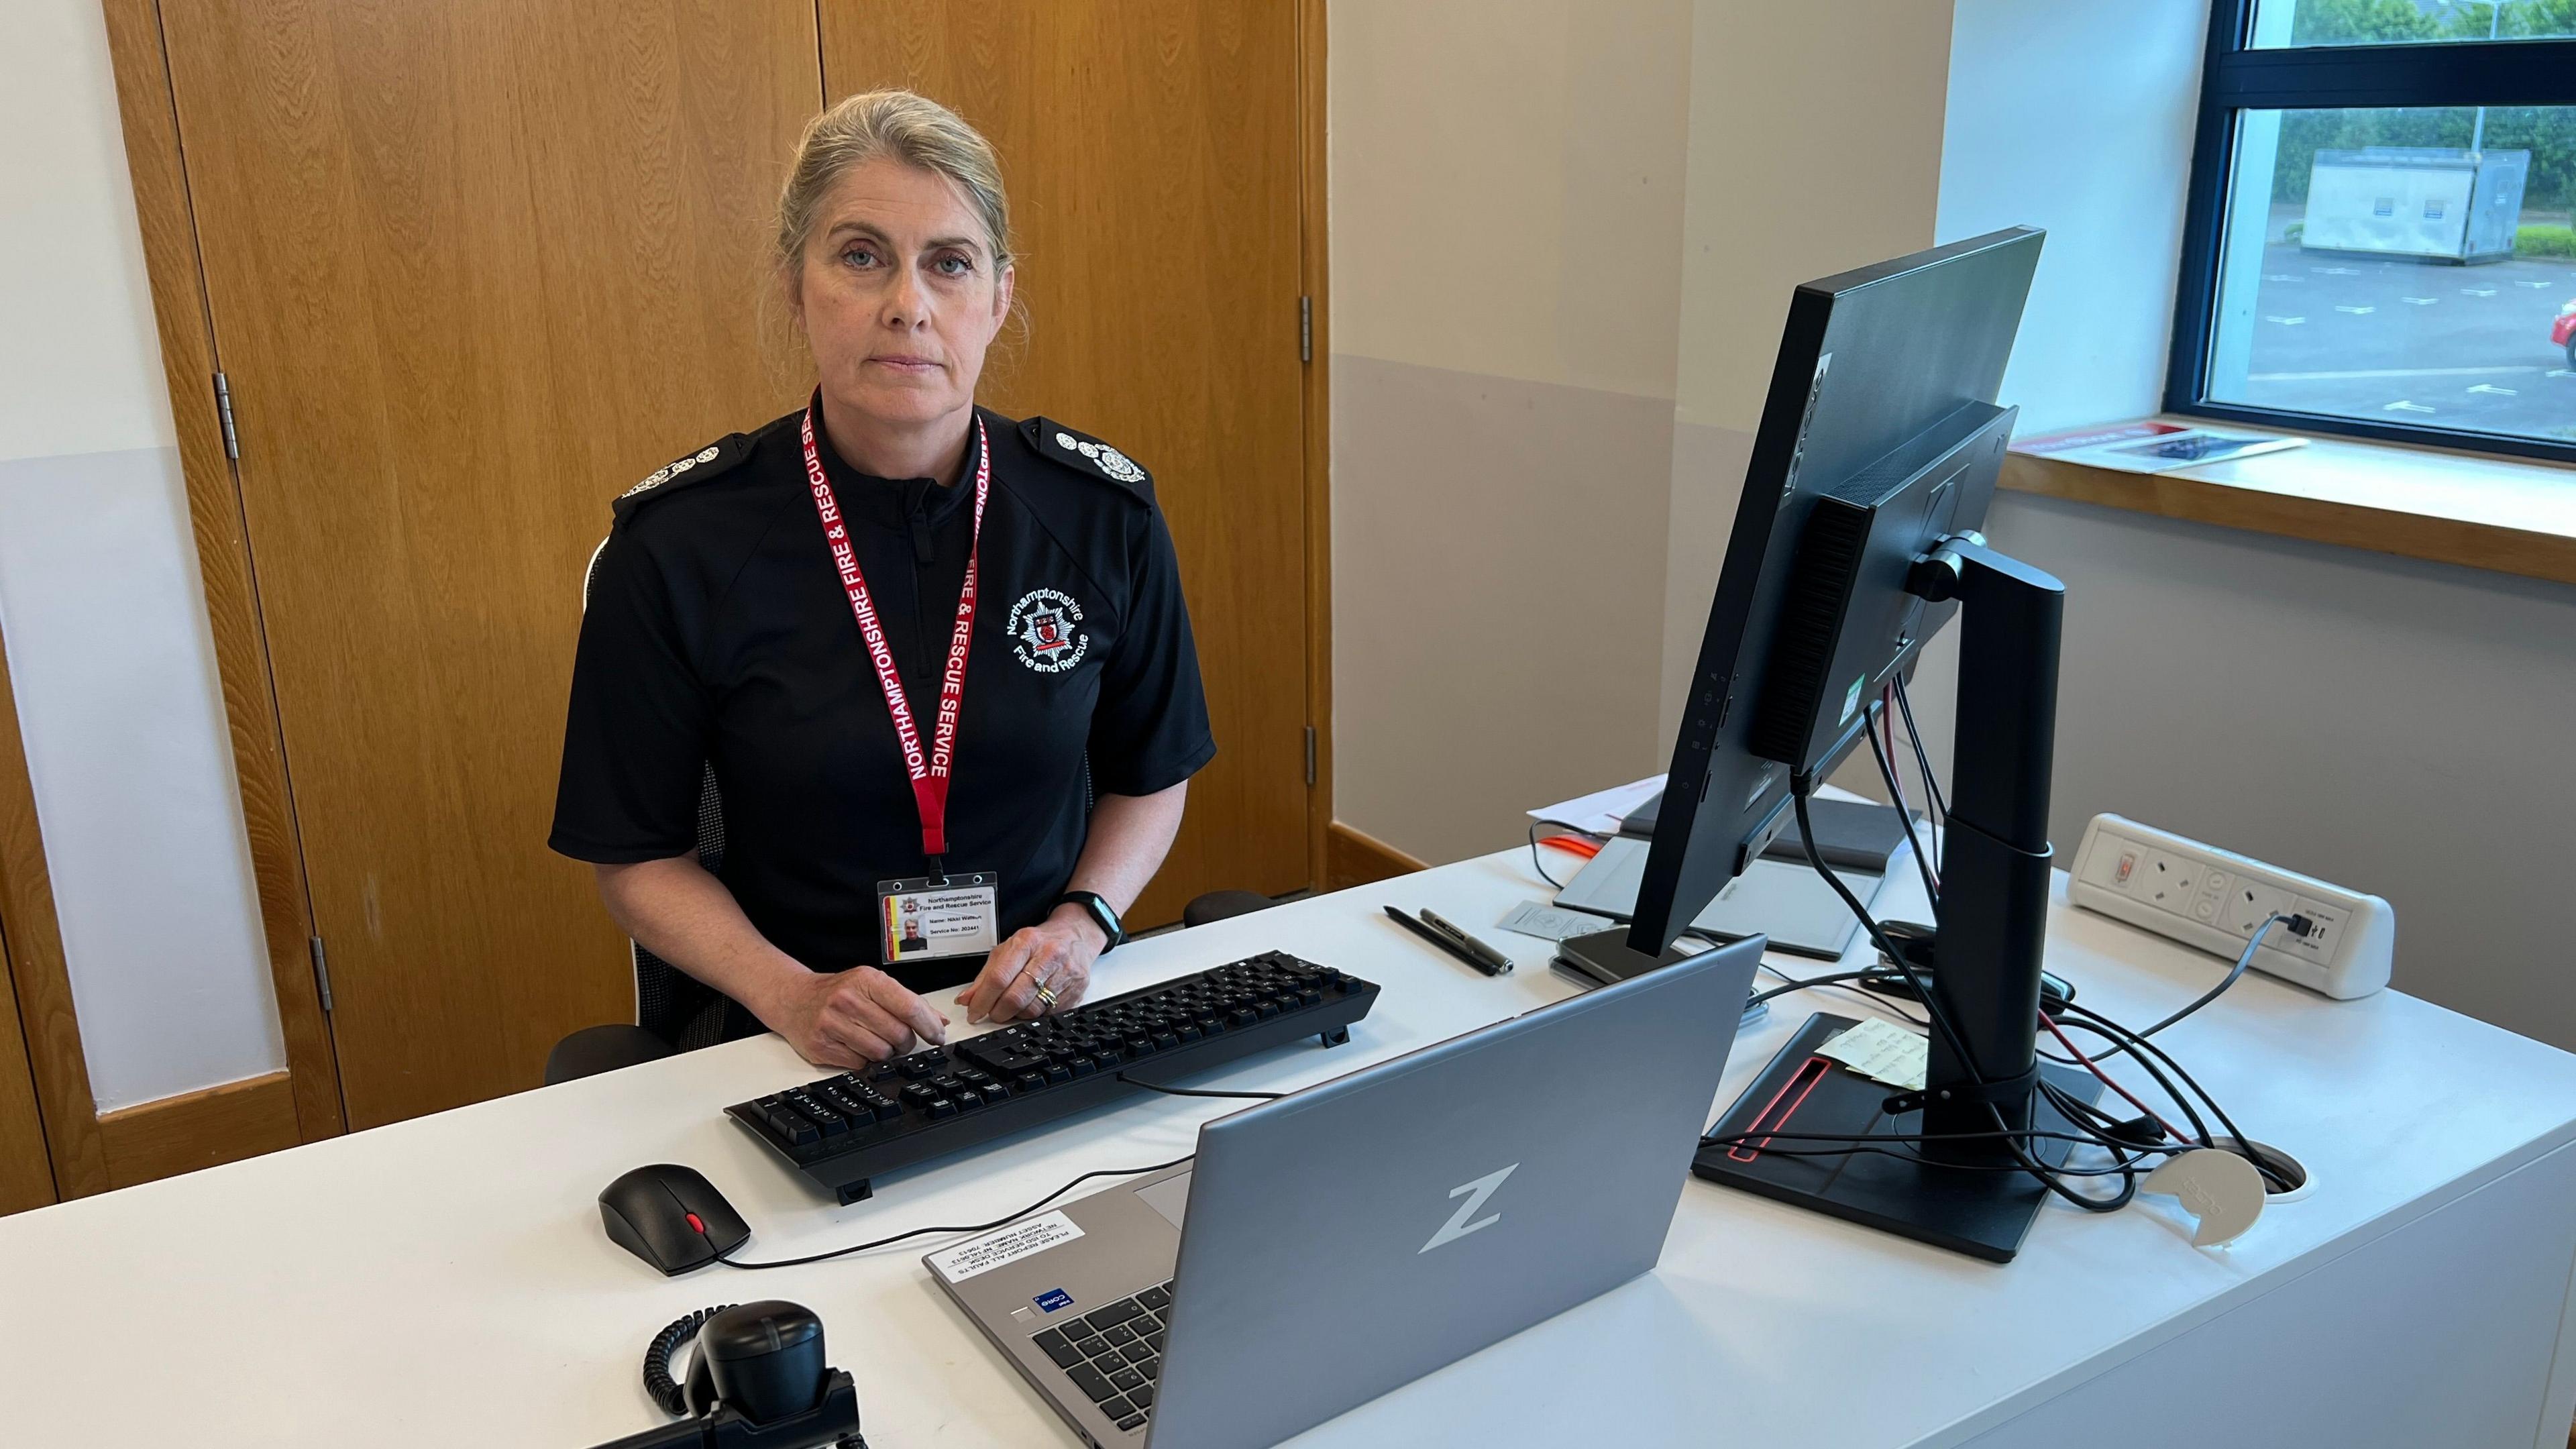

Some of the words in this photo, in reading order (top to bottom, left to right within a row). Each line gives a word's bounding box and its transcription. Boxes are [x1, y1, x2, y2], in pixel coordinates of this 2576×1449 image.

[803, 450, 839, 522] RESCUE
[828, 524, 844, 539] &
[833, 538, 861, 585] FIRE
[962, 559, 975, 598] FIRE
[958, 602, 972, 615] &
[1006, 587, 1083, 636] Northamptonshire
[944, 620, 969, 696] RESCUE
[1013, 645, 1034, 668] Fire
[1034, 662, 1060, 673] and
[1058, 634, 1089, 671] Rescue
[849, 585, 927, 780] NORTHAMPTONSHIRE
[930, 698, 958, 778] SERVICE
[928, 894, 983, 904] Northamptonshire
[1018, 1223, 1042, 1235] ASSET
[1019, 1223, 1058, 1240] NETWORK
[1039, 1231, 1069, 1244] PLEASE
[991, 1242, 1025, 1256] SERVICE
[1007, 1242, 1038, 1257] REPORT
[958, 1260, 989, 1274] FAULTS
[969, 1254, 991, 1265] DESK
